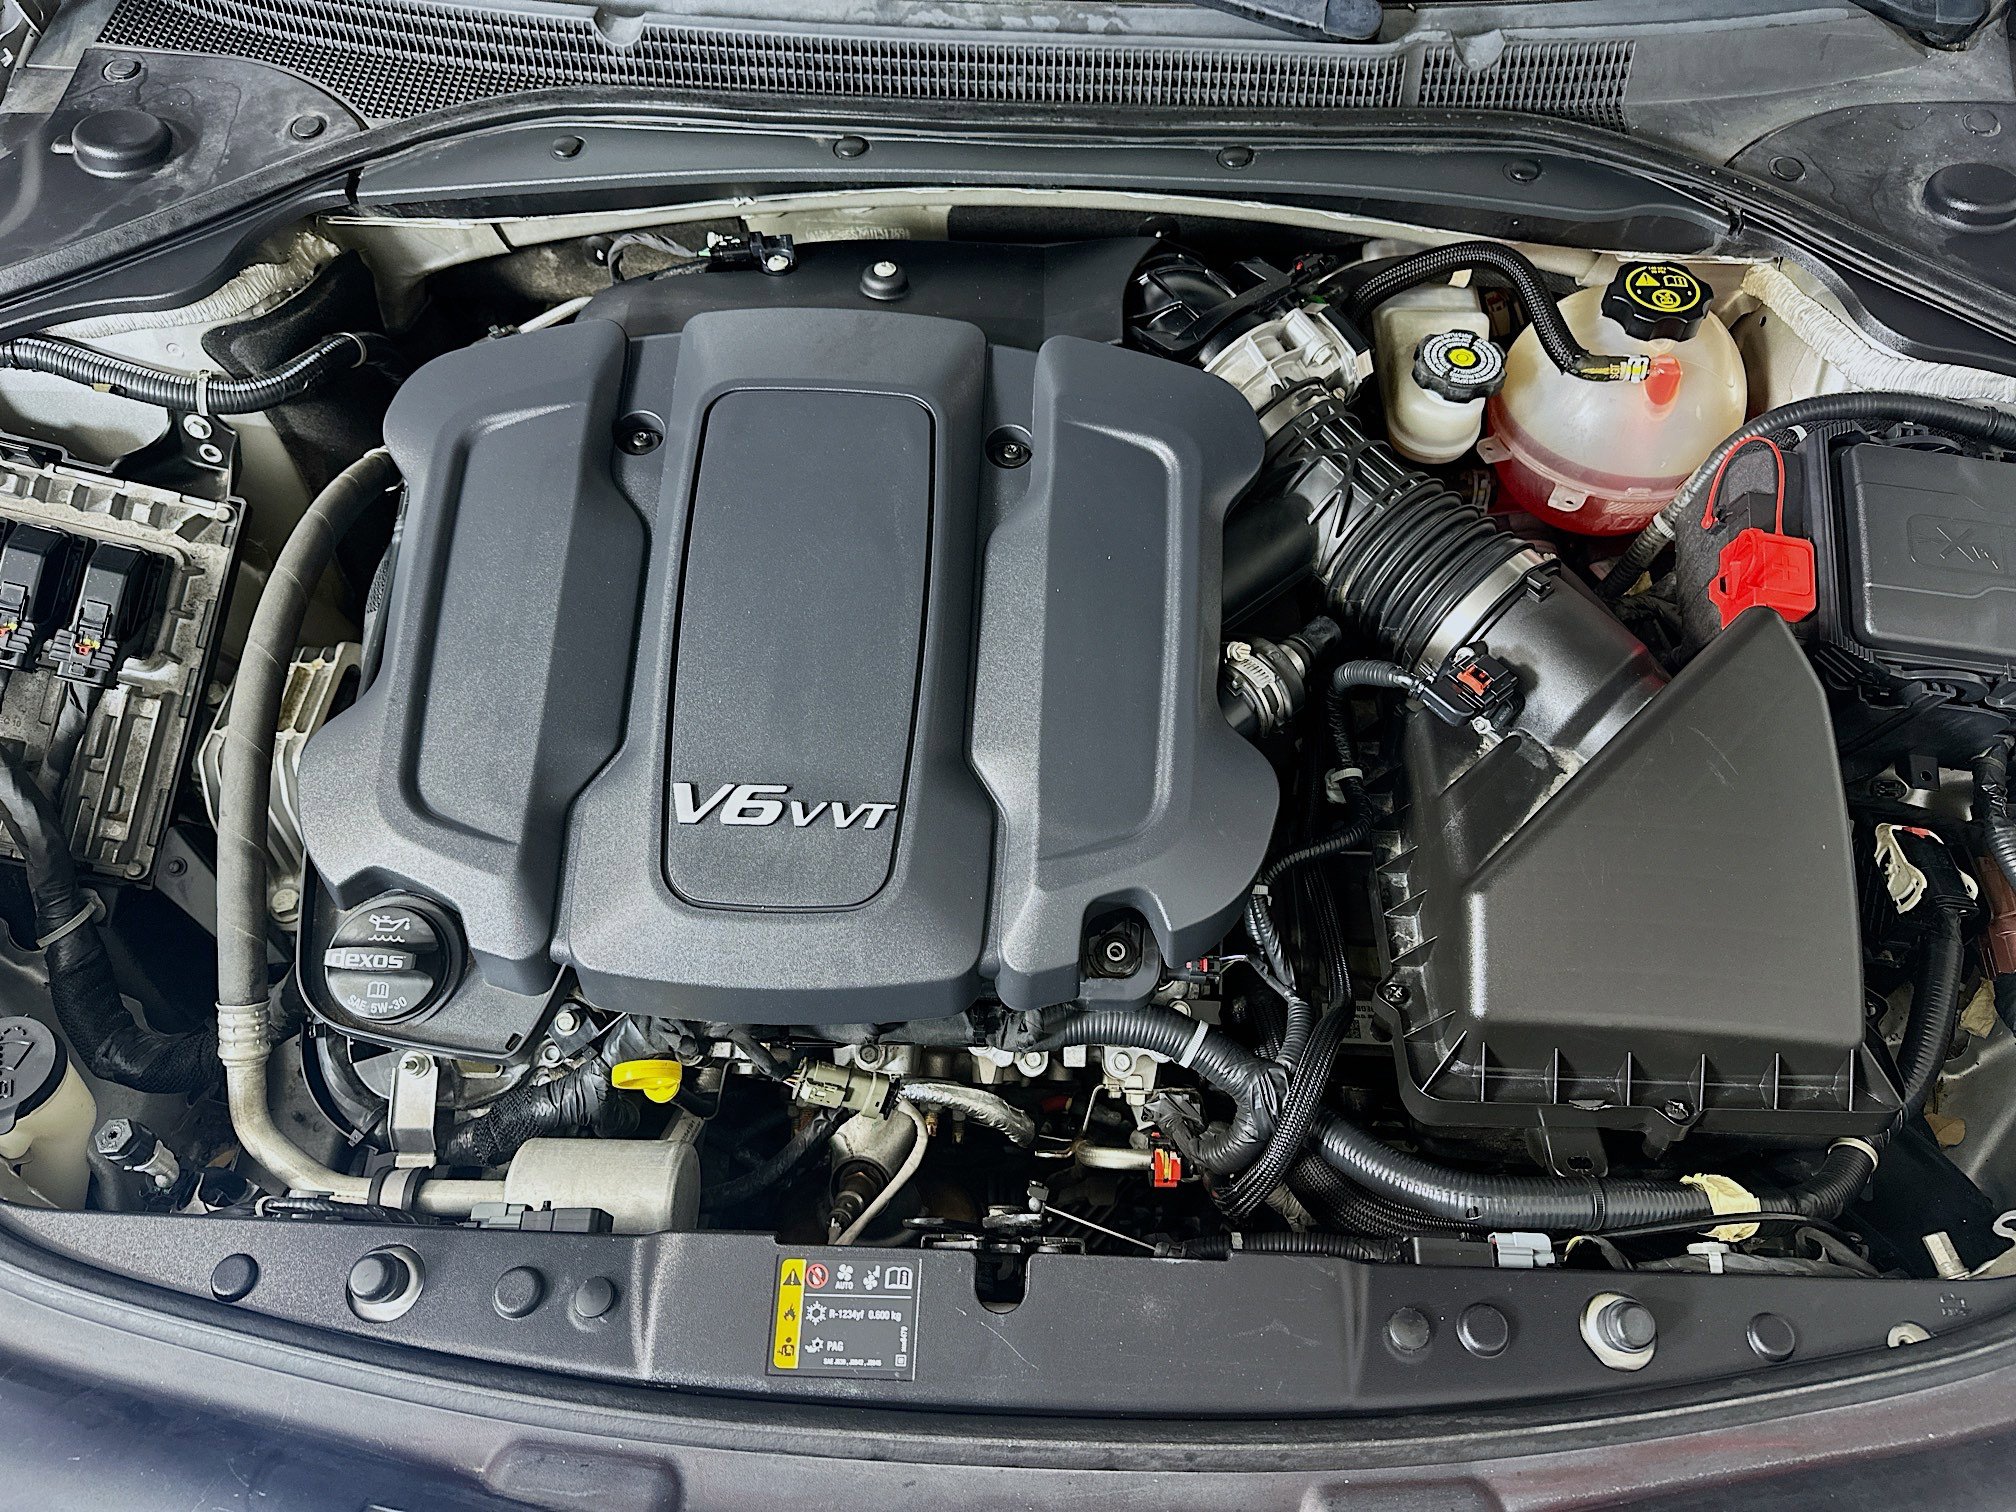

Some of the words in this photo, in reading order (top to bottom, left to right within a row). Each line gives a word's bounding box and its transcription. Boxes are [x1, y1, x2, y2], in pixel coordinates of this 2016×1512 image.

[673, 782, 788, 826] V6
[790, 801, 897, 829] VVT
[348, 995, 367, 1011] SAE
[370, 997, 407, 1013] 5W-30
[835, 1281, 854, 1290] AUTO
[826, 1340, 844, 1352] PAG
